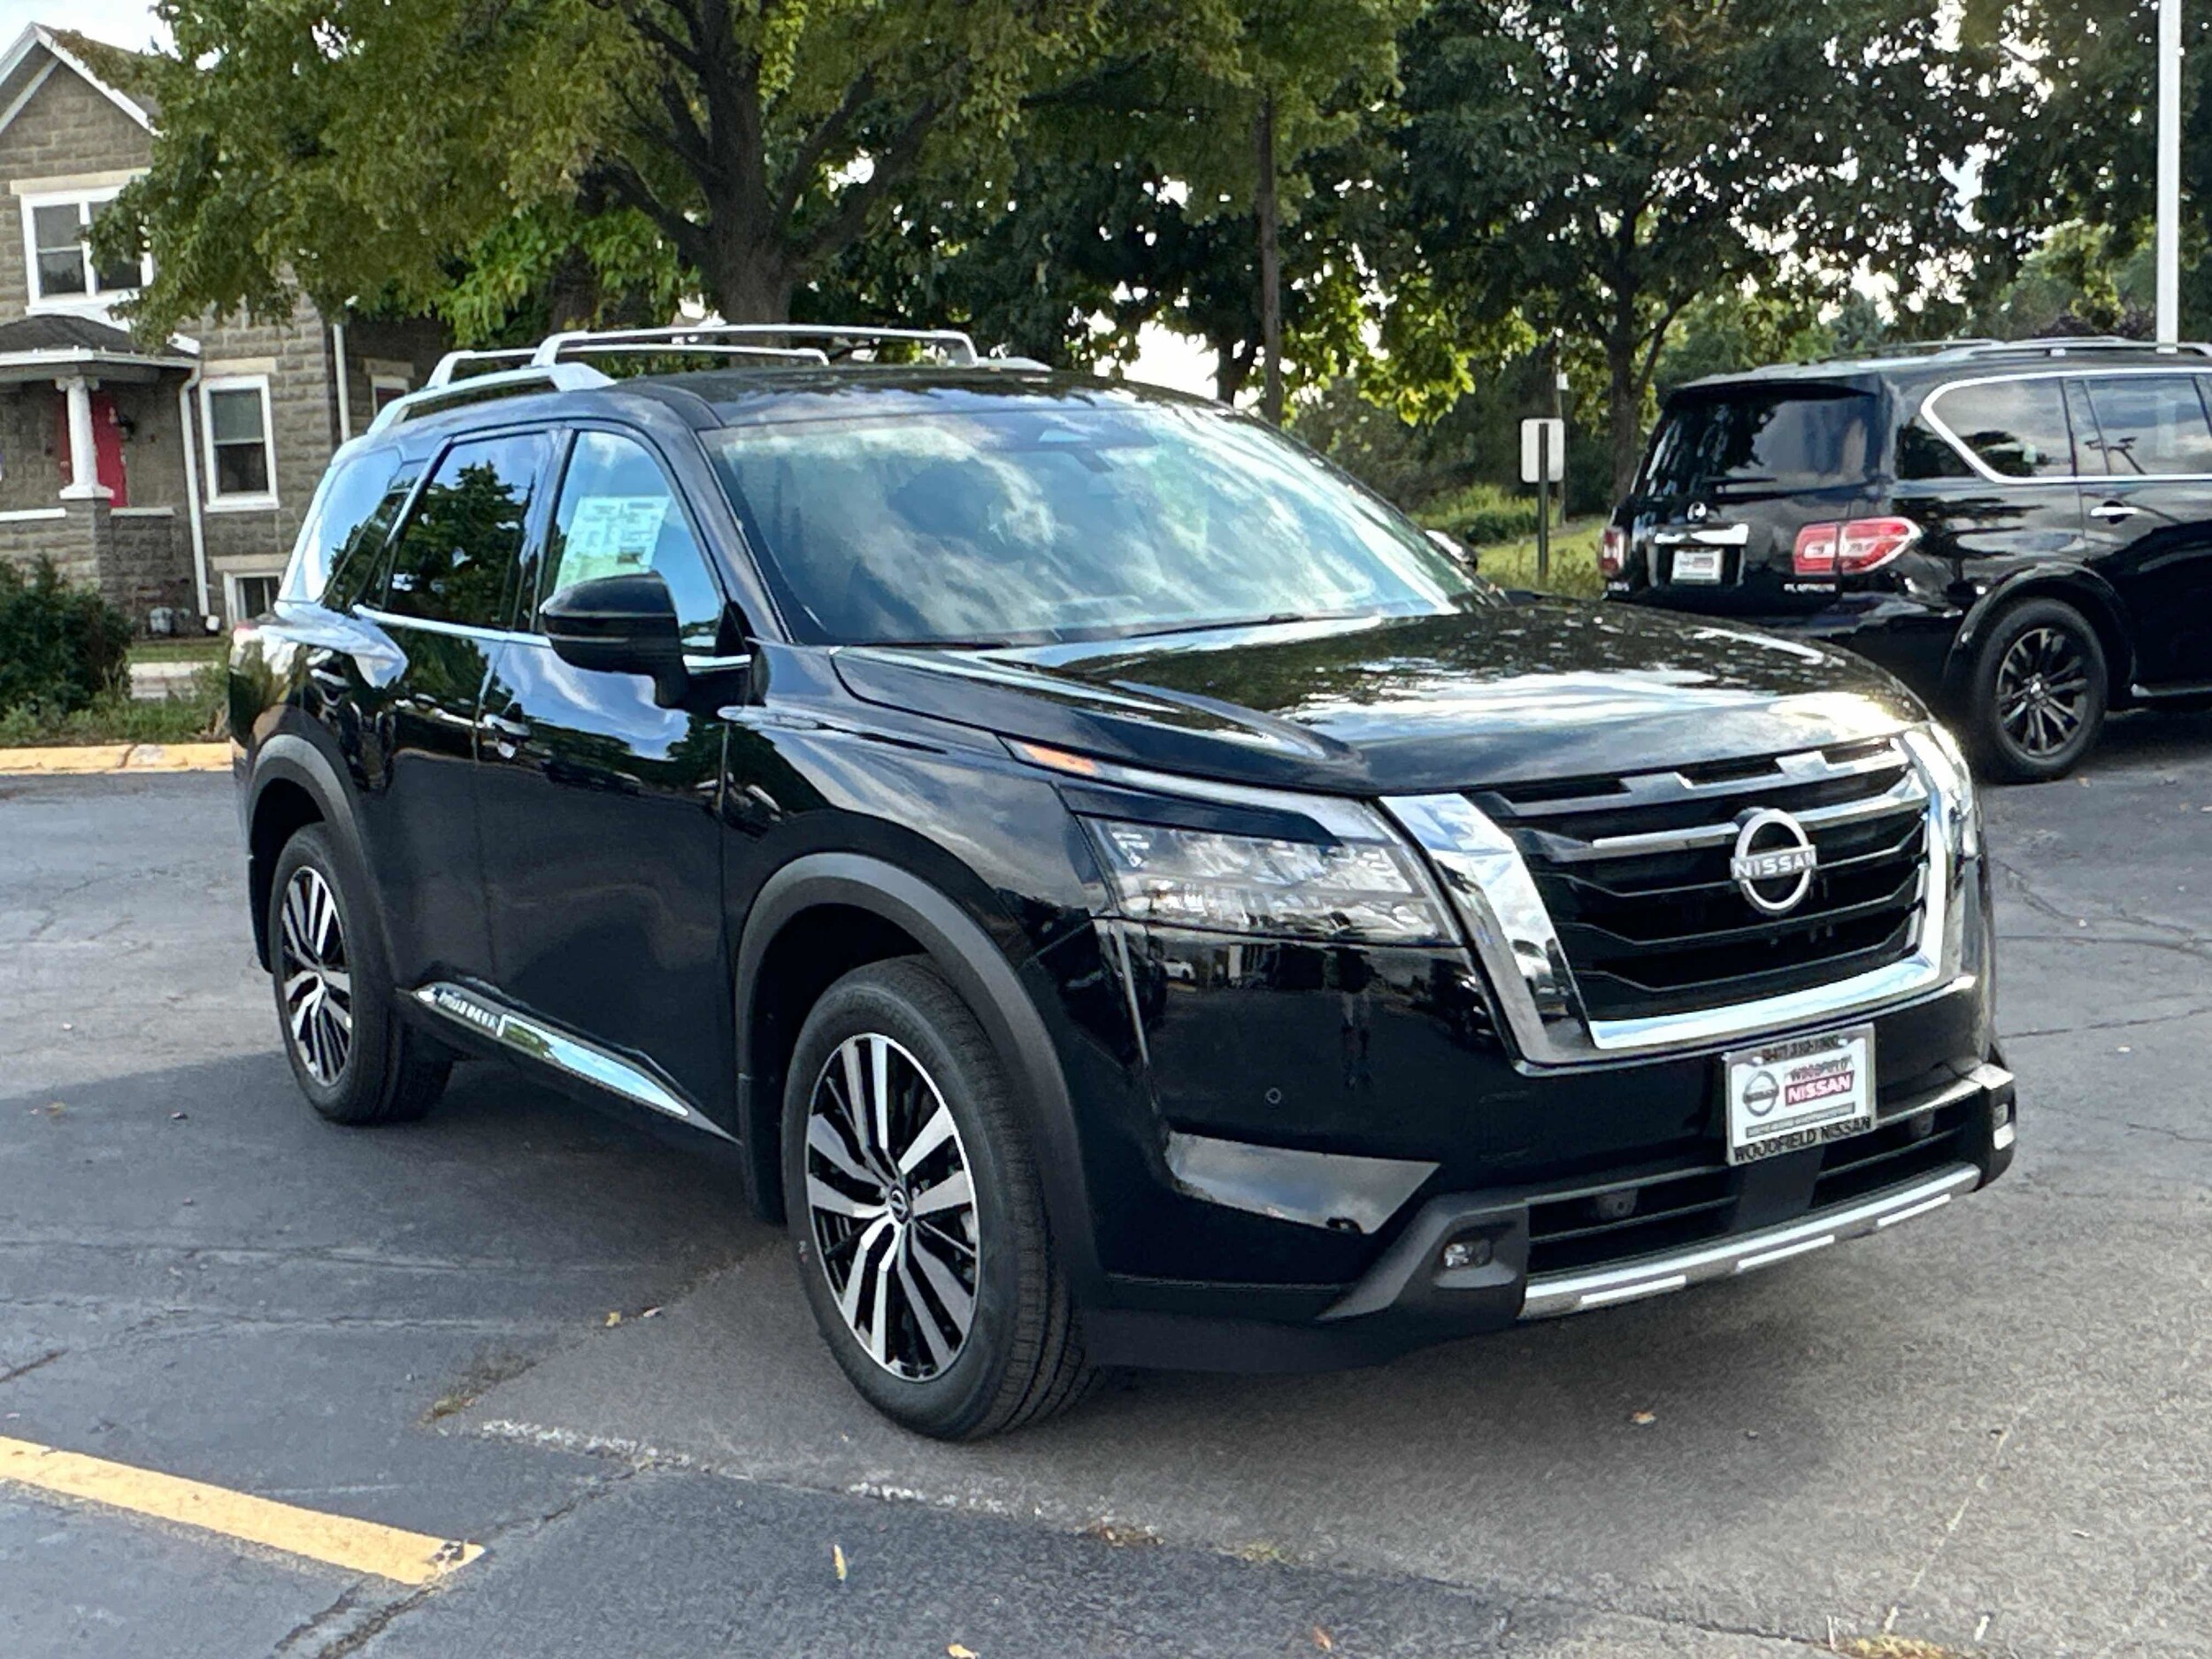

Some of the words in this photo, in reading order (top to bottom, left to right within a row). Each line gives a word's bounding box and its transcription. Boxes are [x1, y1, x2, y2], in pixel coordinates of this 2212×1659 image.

[1733, 851, 1815, 878] NISSAN
[1787, 1075, 1851, 1103] NISSAN
[1820, 1117, 1870, 1141] NISSAN
